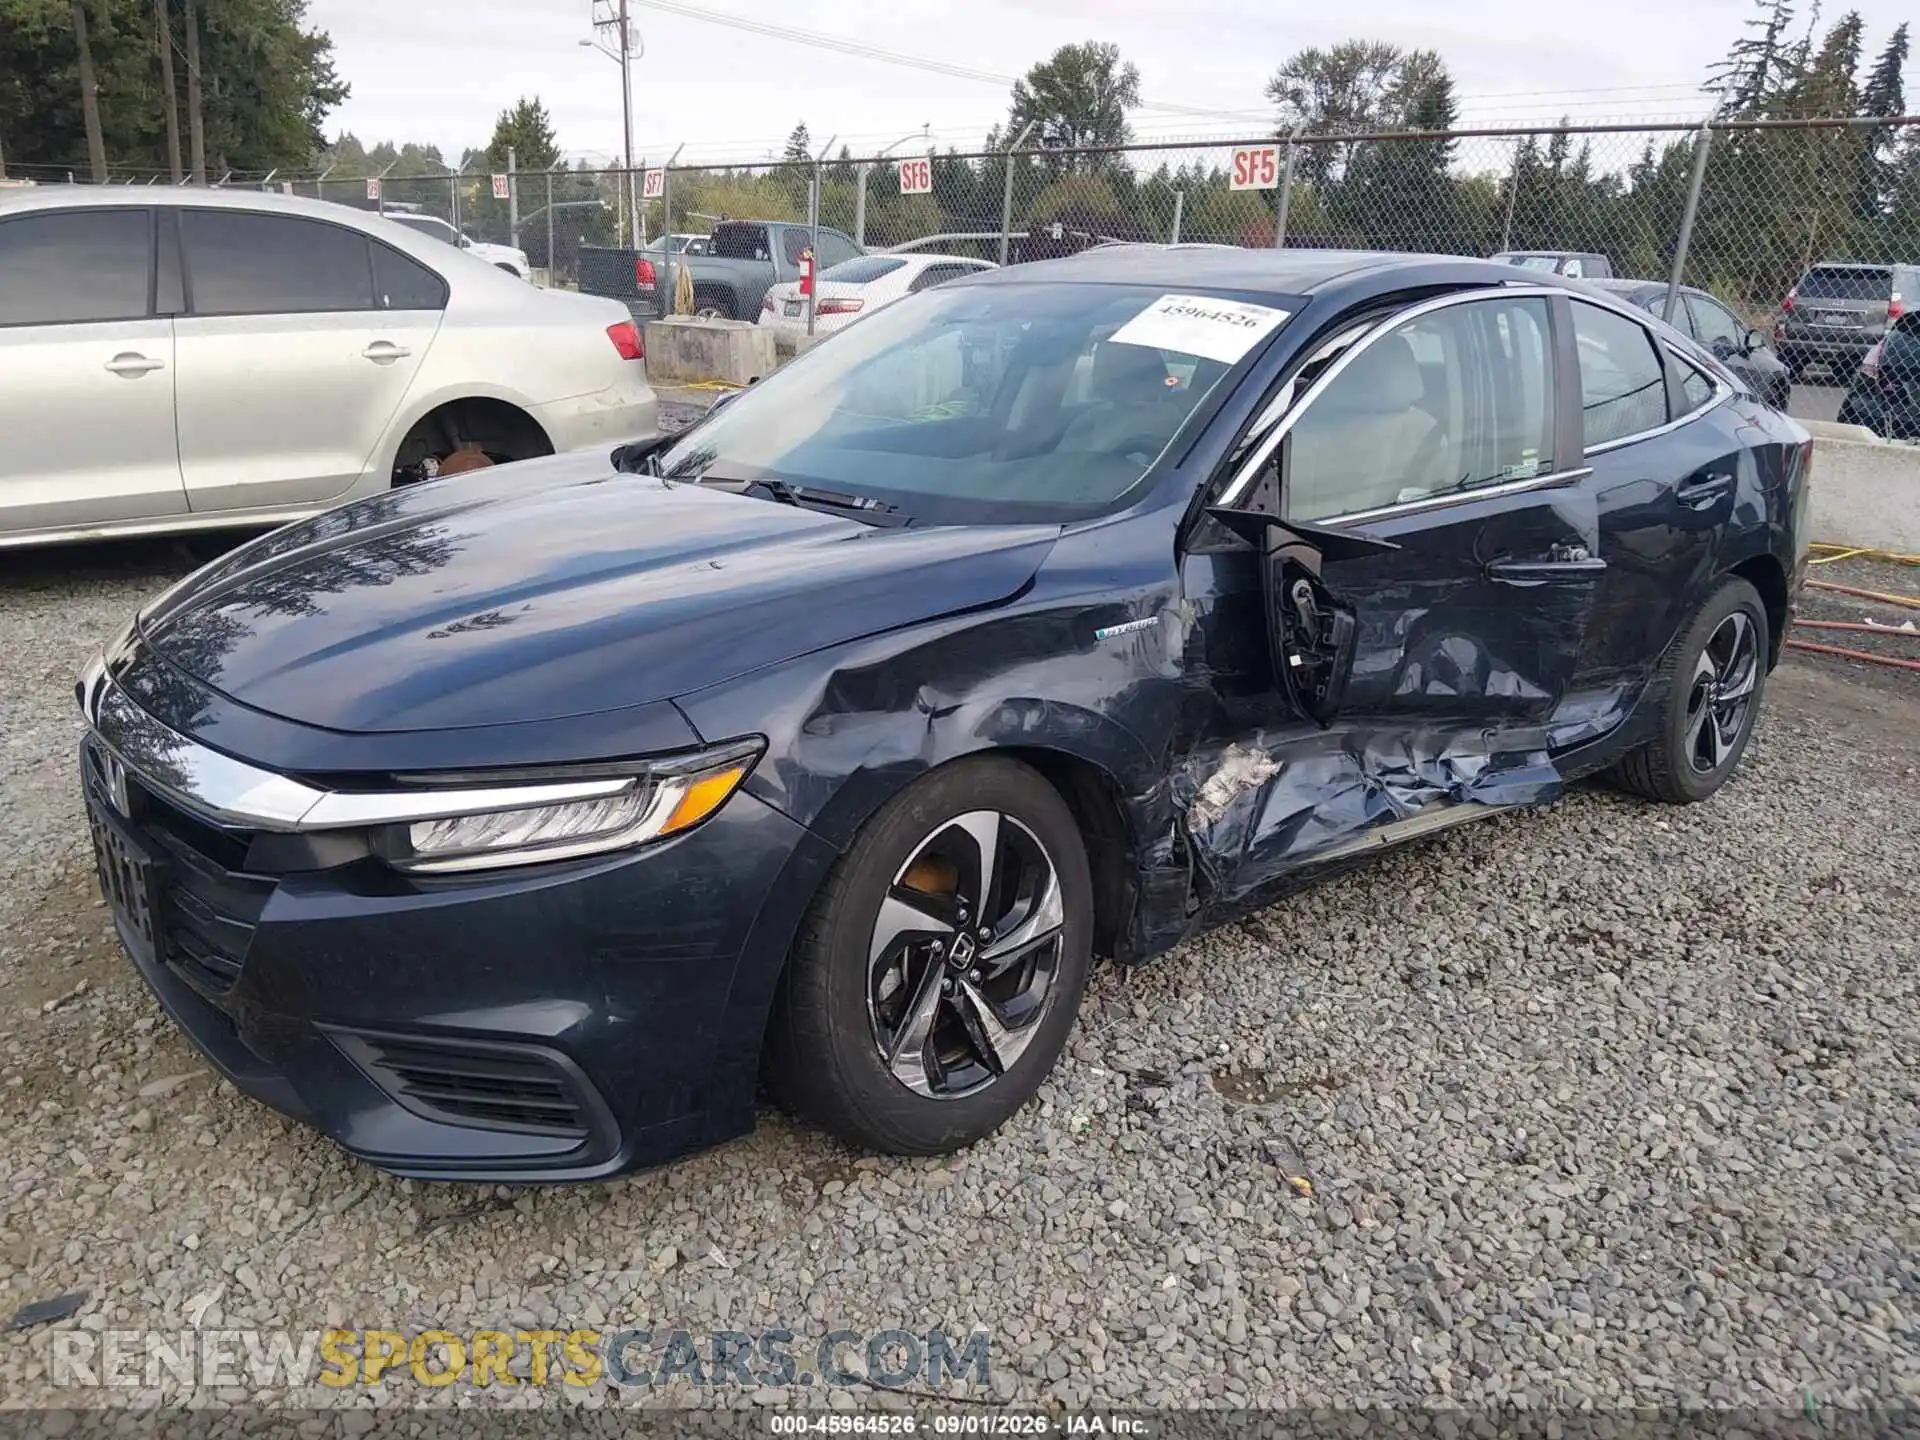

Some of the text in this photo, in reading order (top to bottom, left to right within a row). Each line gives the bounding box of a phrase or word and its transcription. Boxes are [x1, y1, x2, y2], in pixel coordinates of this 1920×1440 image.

[902, 162, 929, 190] SF6
[1234, 149, 1275, 185] SF5
[646, 172, 662, 194] SF7
[1159, 304, 1257, 328] 45964526
